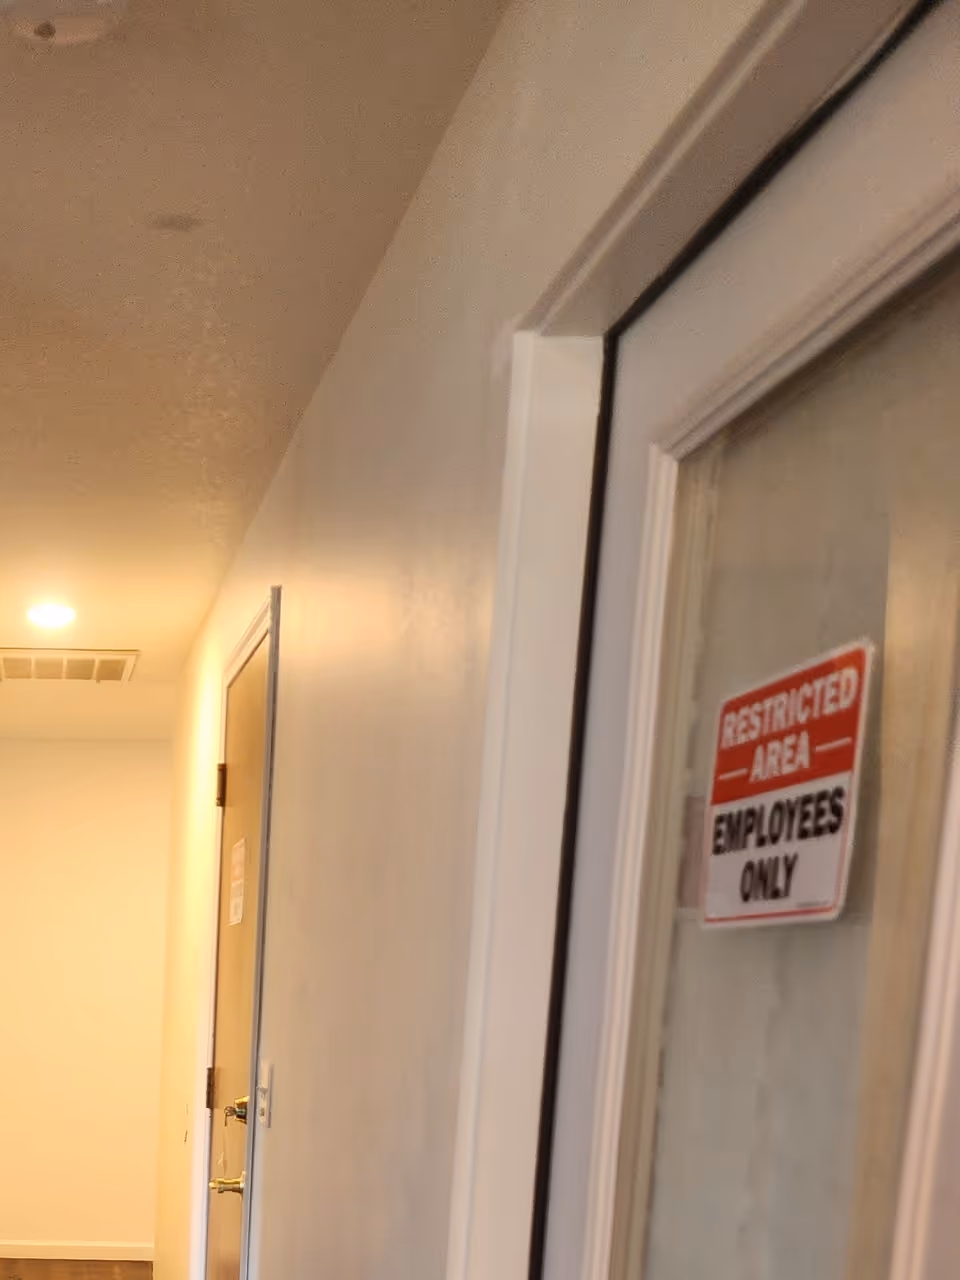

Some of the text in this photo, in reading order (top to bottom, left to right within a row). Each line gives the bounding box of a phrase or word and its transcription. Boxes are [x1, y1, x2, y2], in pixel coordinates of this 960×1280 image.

[719, 666, 859, 749] RESTRICTED
[749, 730, 810, 783] AREA
[712, 786, 844, 856] EMPLOYEES
[740, 852, 799, 903] ONLY
